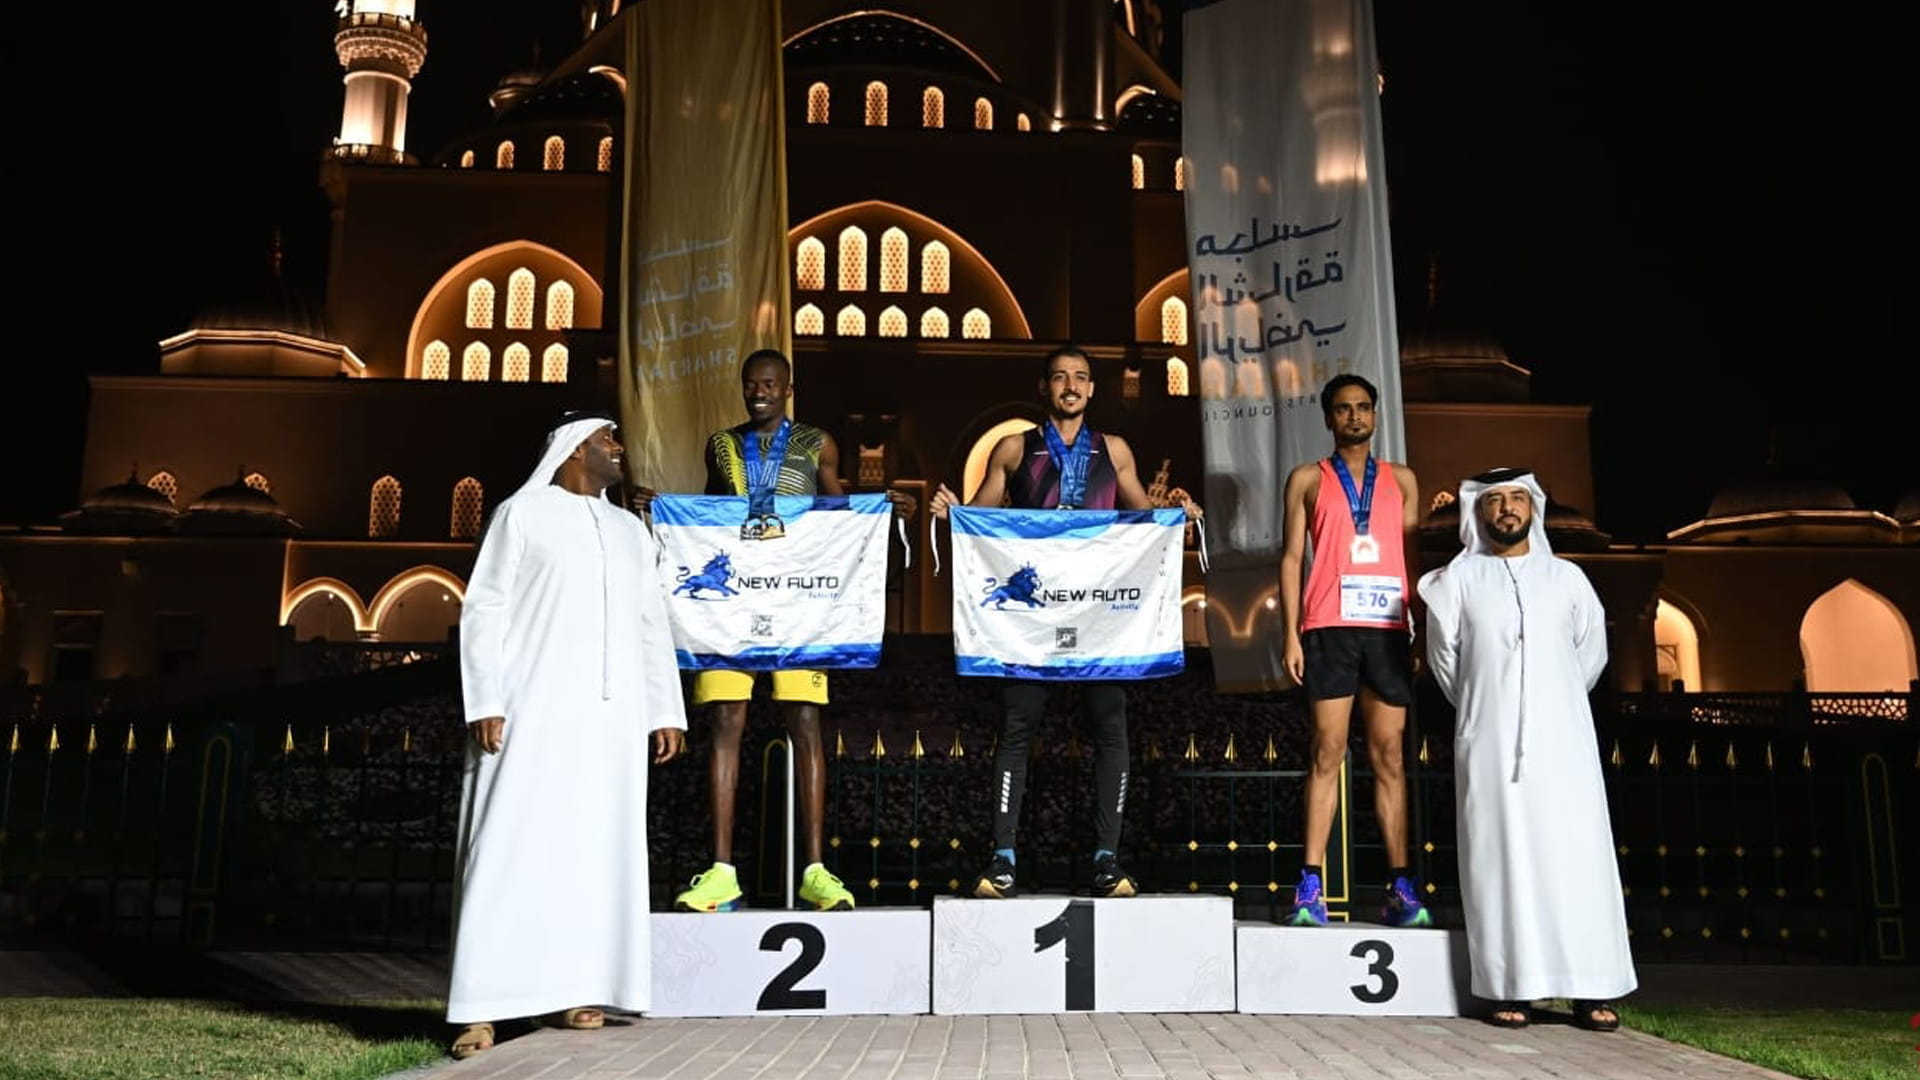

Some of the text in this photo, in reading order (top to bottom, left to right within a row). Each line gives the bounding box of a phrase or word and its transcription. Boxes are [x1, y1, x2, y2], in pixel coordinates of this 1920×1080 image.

[737, 576, 839, 589] NEW AUTO
[1043, 588, 1141, 602] NEW AUTO
[1357, 592, 1388, 608] 576
[756, 922, 827, 1011] 2
[1034, 900, 1095, 1011] 1
[1350, 940, 1399, 1004] 3
